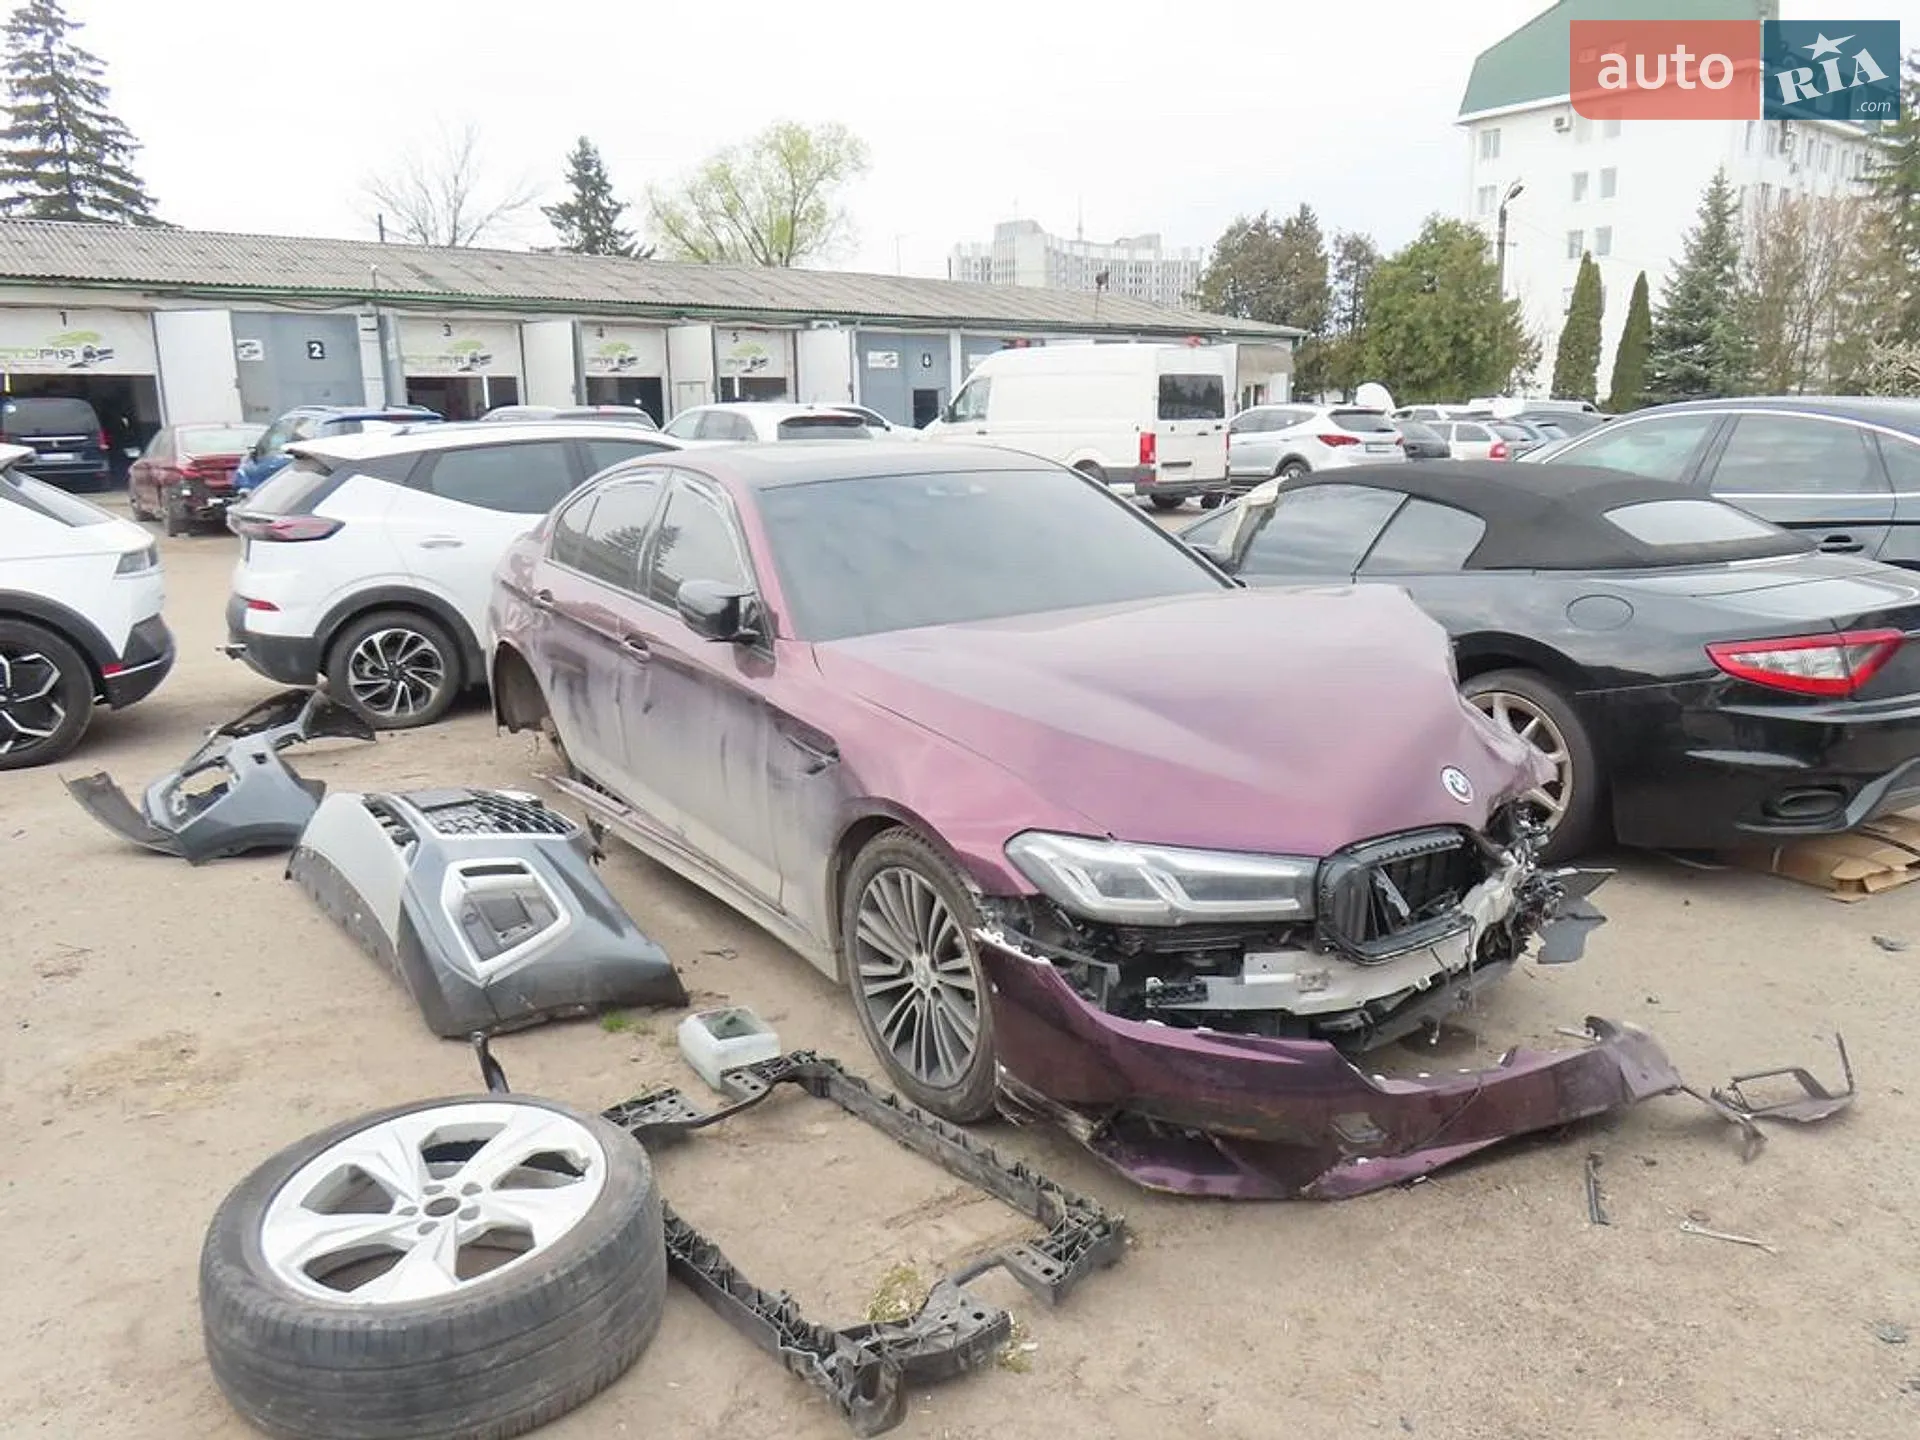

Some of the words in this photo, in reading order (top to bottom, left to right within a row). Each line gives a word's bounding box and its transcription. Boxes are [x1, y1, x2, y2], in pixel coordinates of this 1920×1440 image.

[59, 311, 67, 327] 1
[443, 324, 452, 337] 3
[309, 342, 325, 359] 2
